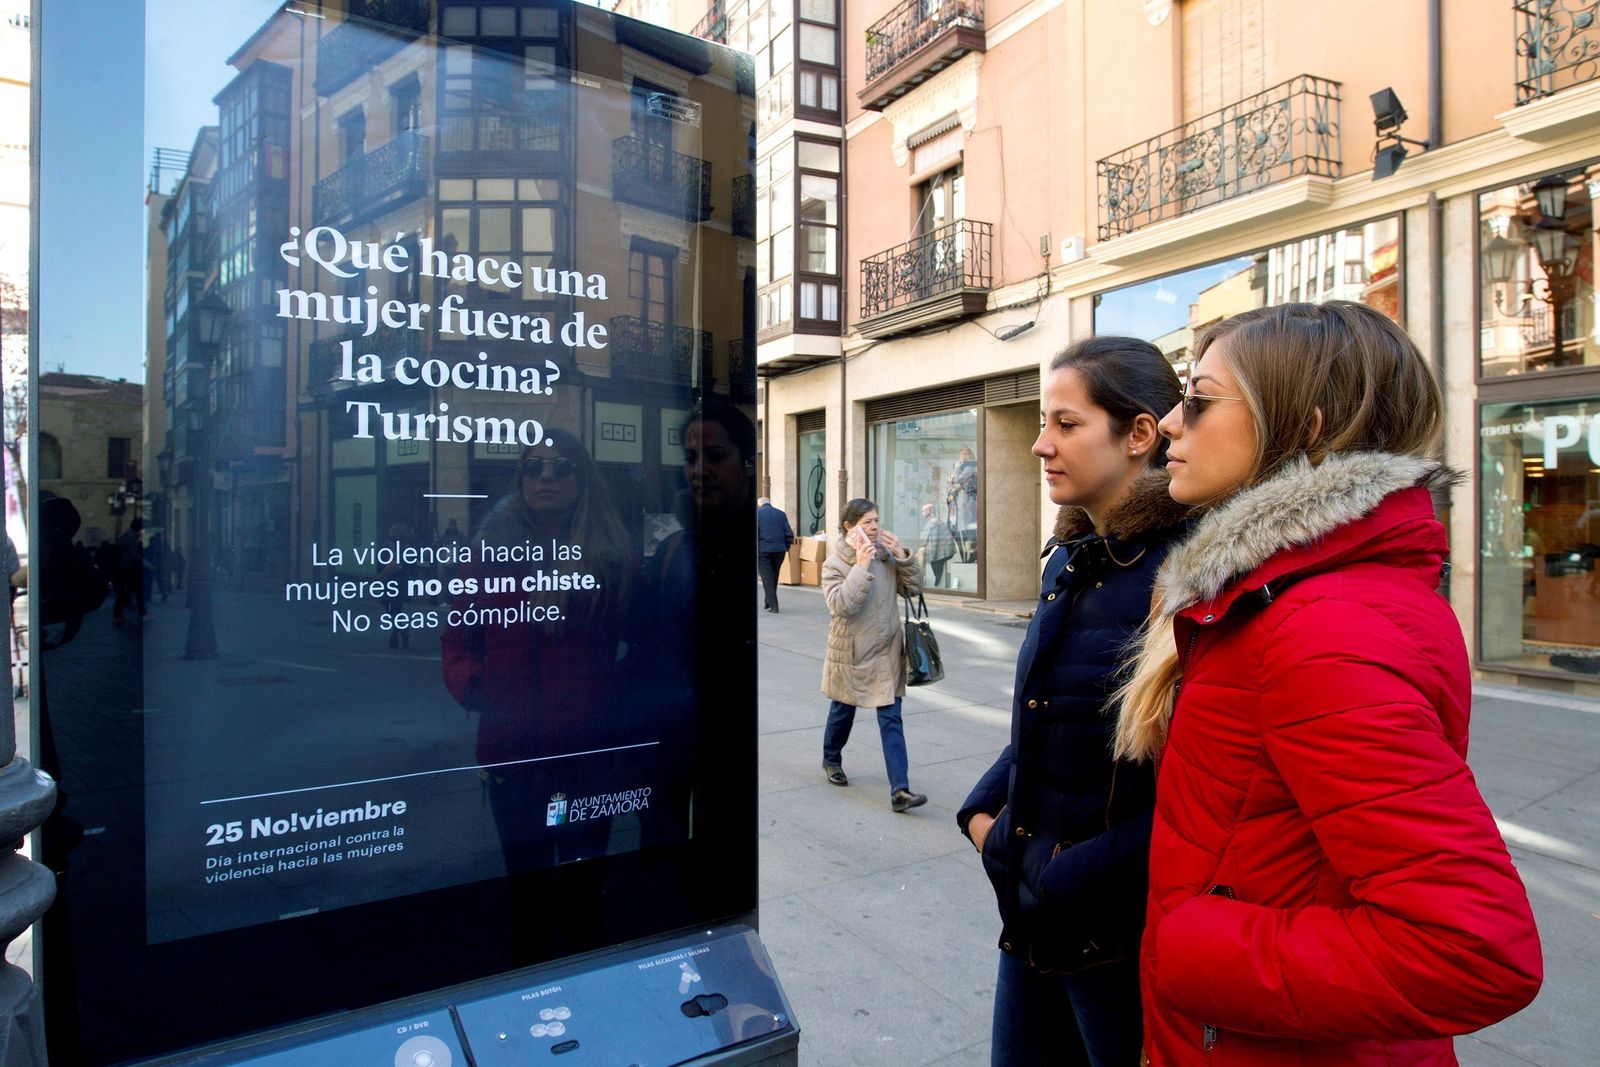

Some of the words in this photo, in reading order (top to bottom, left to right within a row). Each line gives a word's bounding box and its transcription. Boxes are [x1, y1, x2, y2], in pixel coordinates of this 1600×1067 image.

[280, 226, 409, 278] ¿Qué
[419, 237, 522, 288] hace
[531, 267, 608, 300] una
[276, 285, 431, 337] mujer
[439, 294, 553, 344] fuera
[561, 312, 608, 349] de
[339, 340, 385, 383] la
[394, 351, 560, 396] cocina?
[346, 401, 553, 447] Turismo.
[312, 543, 343, 566] La
[353, 541, 472, 565] violencia
[481, 540, 544, 562] hacia
[552, 539, 582, 561] las
[286, 576, 399, 605] mujeres
[407, 578, 442, 596] no
[448, 578, 478, 595] es
[484, 576, 516, 593] un
[521, 569, 600, 592] chiste.
[332, 610, 370, 633] No
[379, 611, 438, 630] seas
[447, 601, 566, 628] cómplice.
[569, 807, 588, 822] DE
[590, 797, 649, 819] ZAMORA
[570, 787, 652, 809] AYUNTAMIENTO
[205, 821, 244, 846] 25
[250, 800, 407, 839] No!viembre
[205, 864, 274, 884] violencia
[278, 854, 318, 871] hacia
[323, 849, 343, 863] las
[347, 841, 404, 859] mujeres
[206, 856, 232, 870] Día
[237, 835, 341, 864] internacional
[346, 830, 389, 844] contra
[393, 825, 404, 837] la
[638, 962, 655, 970] PILAS
[521, 991, 540, 1001] PILAS
[397, 1025, 407, 1034] CD
[413, 1020, 429, 1029] DVD
